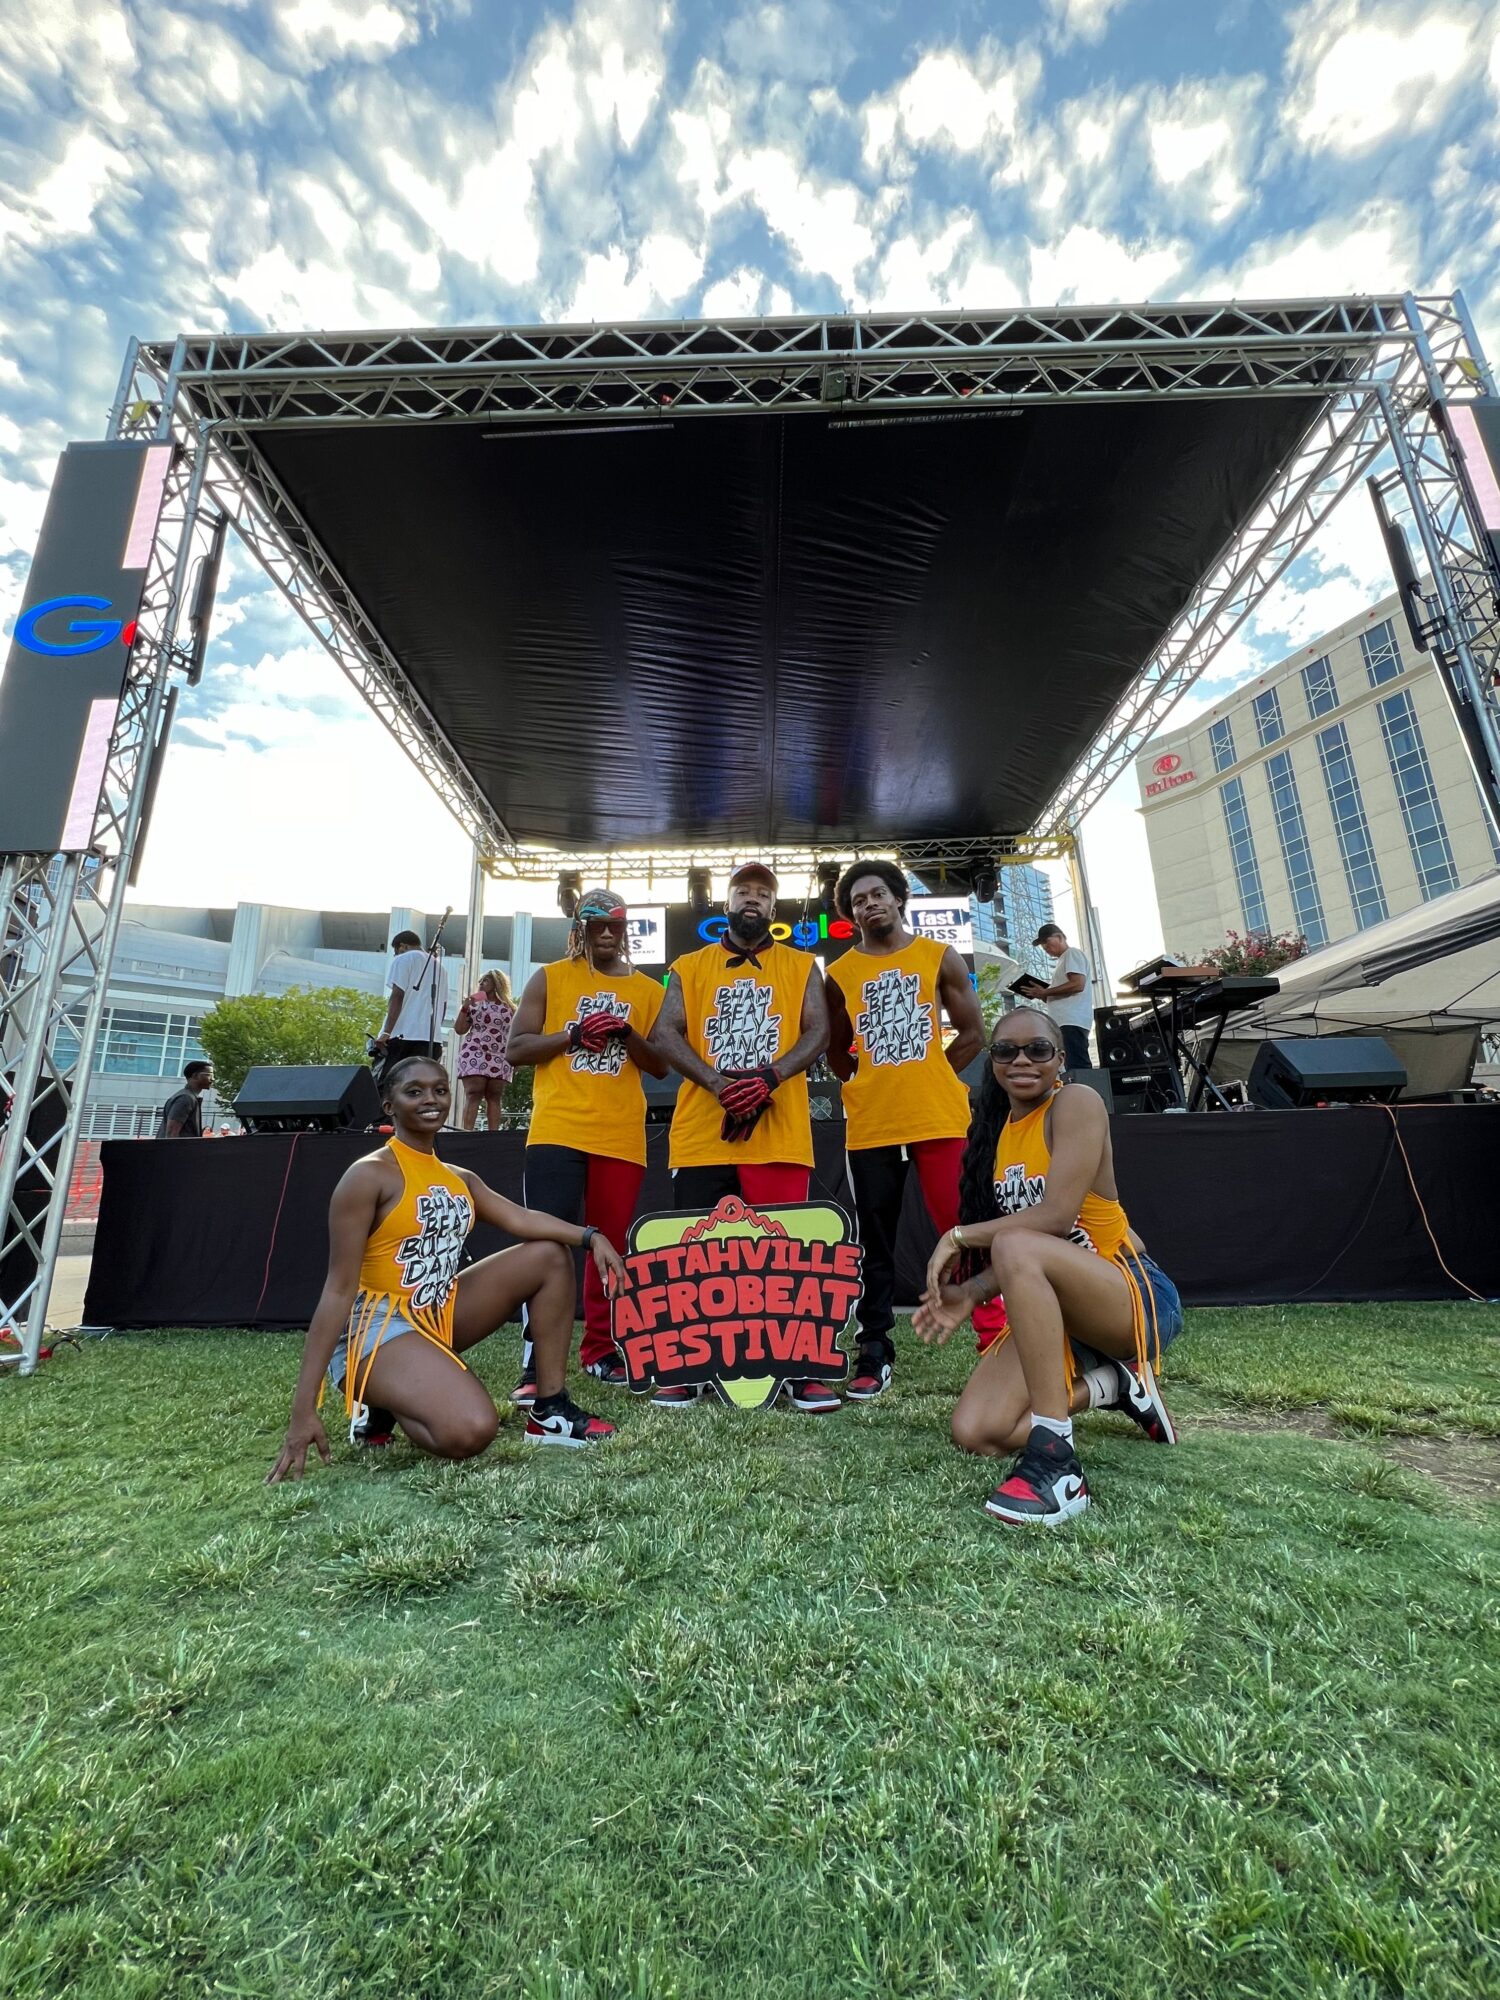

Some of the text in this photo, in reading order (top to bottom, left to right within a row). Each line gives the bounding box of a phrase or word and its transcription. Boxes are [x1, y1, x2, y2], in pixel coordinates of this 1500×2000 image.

[14, 594, 138, 657] G
[1145, 770, 1197, 797] Hilton
[697, 914, 854, 947] Gogle
[917, 911, 955, 926] fast
[715, 988, 771, 1005] BHAM
[863, 975, 919, 1001] BHAM
[579, 997, 629, 1018] BHAM
[718, 1001, 769, 1023] BEAT
[867, 990, 917, 1017] BEAT
[705, 1016, 780, 1036] BULLYZ
[857, 1004, 931, 1032] BULLYZ
[709, 1033, 777, 1054] DANCE
[865, 1022, 931, 1049] DANCE
[572, 1053, 622, 1074] CREW
[873, 1040, 925, 1064] CREW
[994, 1178, 1045, 1206] BHAM
[422, 1213, 470, 1240] BEAT
[403, 1255, 459, 1285] DAN
[615, 1275, 860, 1338] AFROBEAT
[625, 1319, 844, 1380] FESTIVAL
